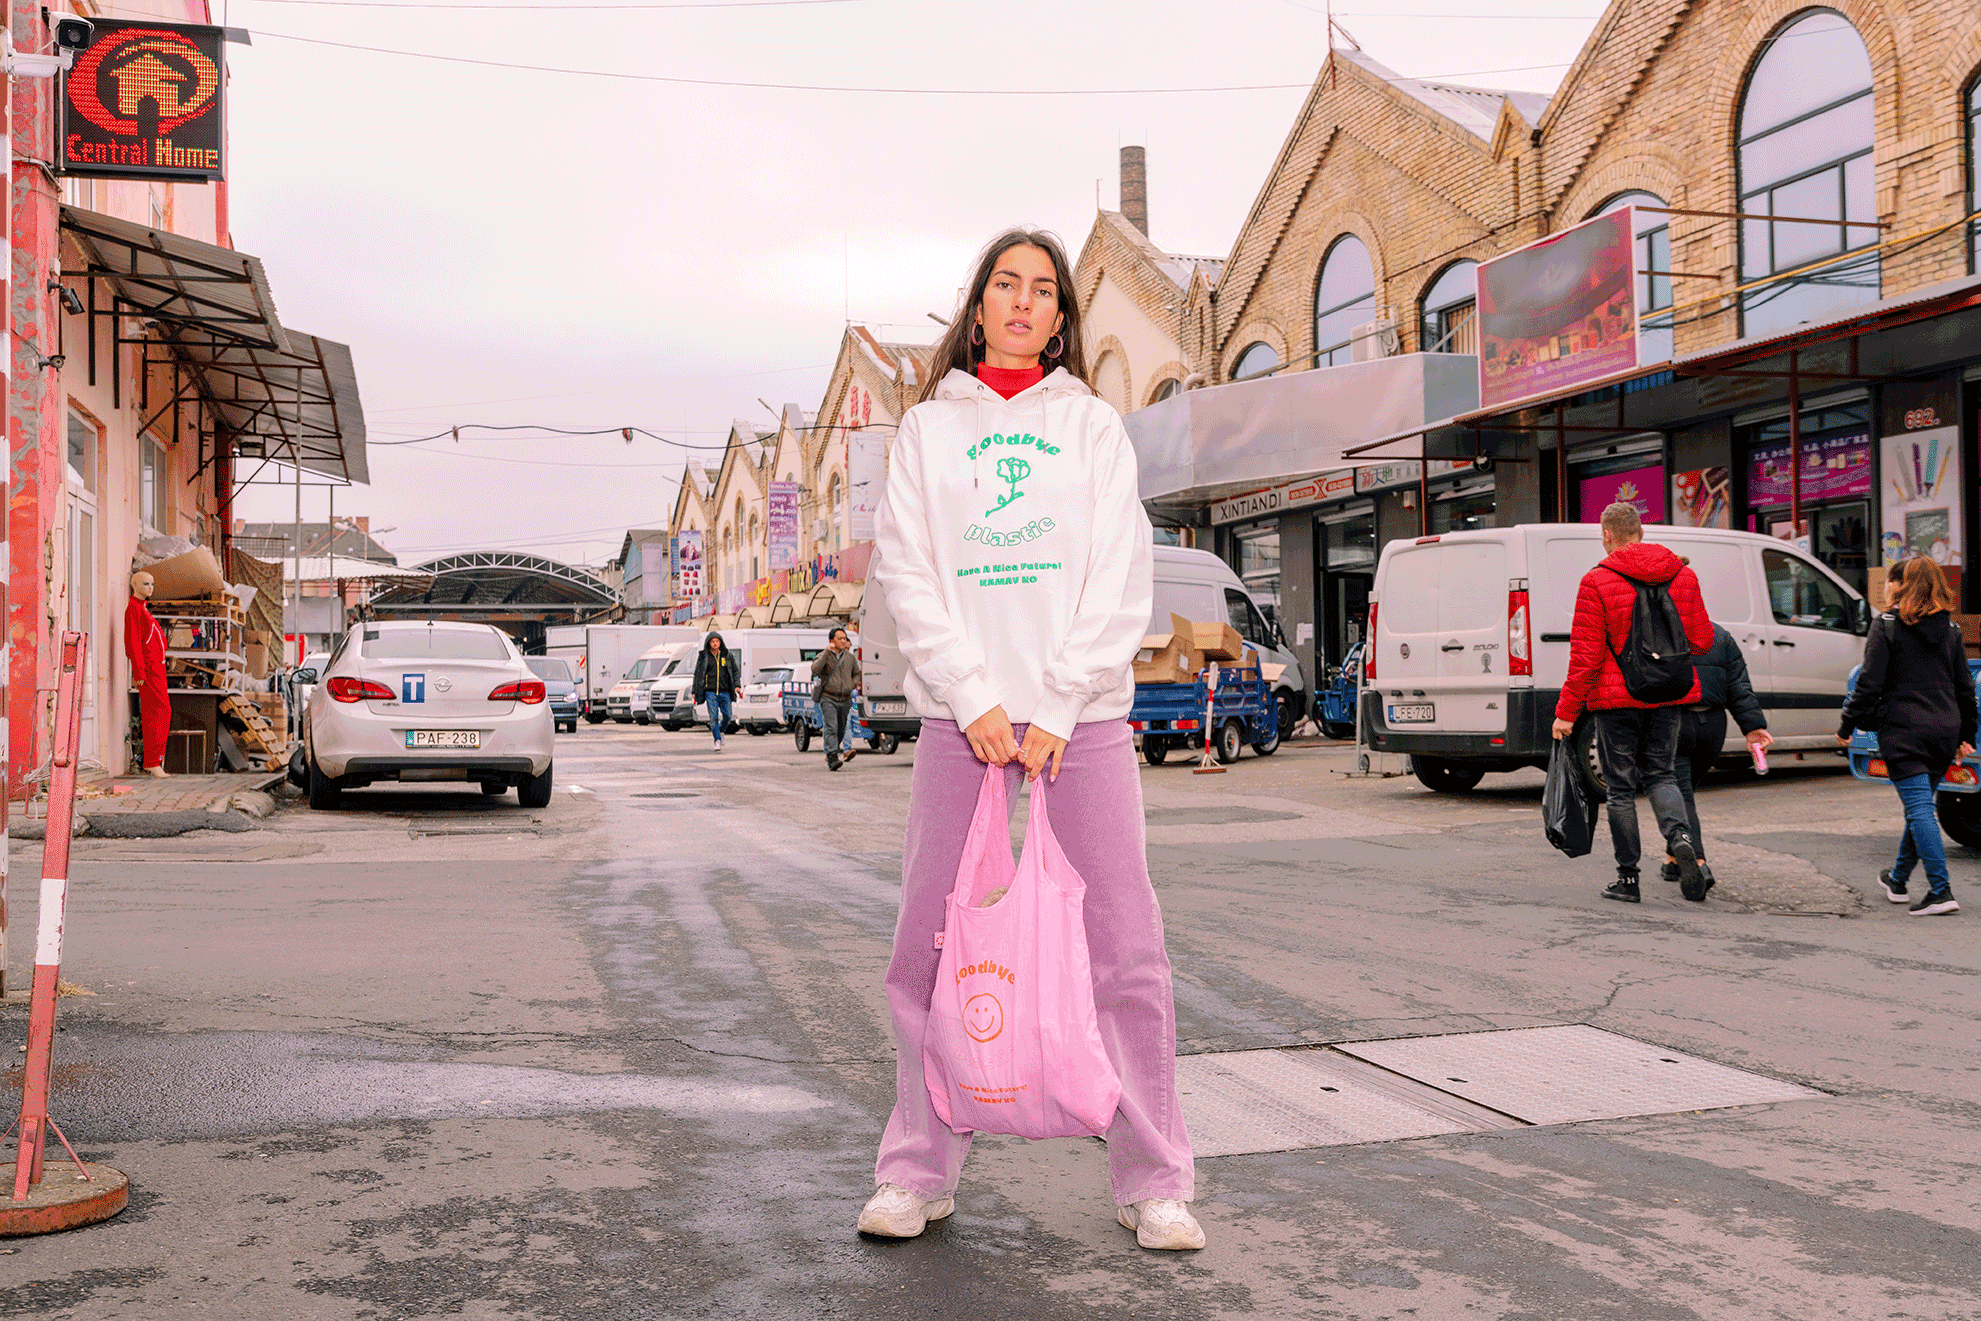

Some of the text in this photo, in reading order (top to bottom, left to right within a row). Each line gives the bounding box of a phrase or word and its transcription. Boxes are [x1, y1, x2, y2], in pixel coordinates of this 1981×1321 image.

[66, 133, 219, 169] Central Home
[967, 434, 1061, 460] goodbye
[1361, 466, 1395, 488] 新天地
[1220, 492, 1282, 521] XINTIANDI
[963, 517, 1055, 547] plastic
[956, 562, 1062, 578] Have A Nice Future!
[404, 676, 424, 701] T
[1394, 706, 1432, 719] LFE-720
[416, 732, 477, 744] PAF-238
